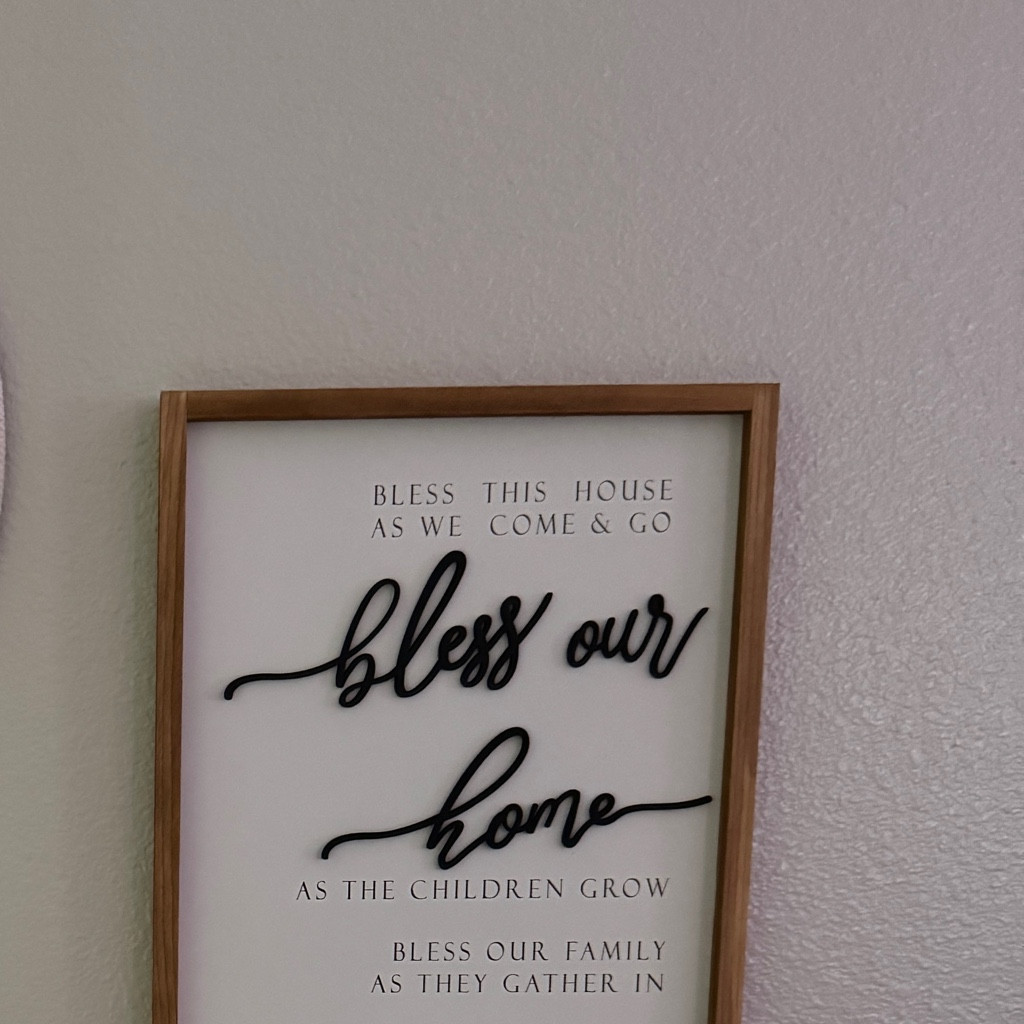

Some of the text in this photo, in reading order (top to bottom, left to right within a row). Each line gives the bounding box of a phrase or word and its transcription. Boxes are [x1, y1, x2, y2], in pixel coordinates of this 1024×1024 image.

[373, 479, 673, 506] BLESS THIS HOUSE
[370, 511, 672, 539] AS WE COME & GO
[223, 550, 710, 709] bless our
[321, 727, 713, 869] home
[295, 877, 670, 901] AS THE CHILDREN GROW
[393, 940, 666, 962] BLESS OUR FAMILY
[370, 973, 664, 994] AS THEY GATHER IN
